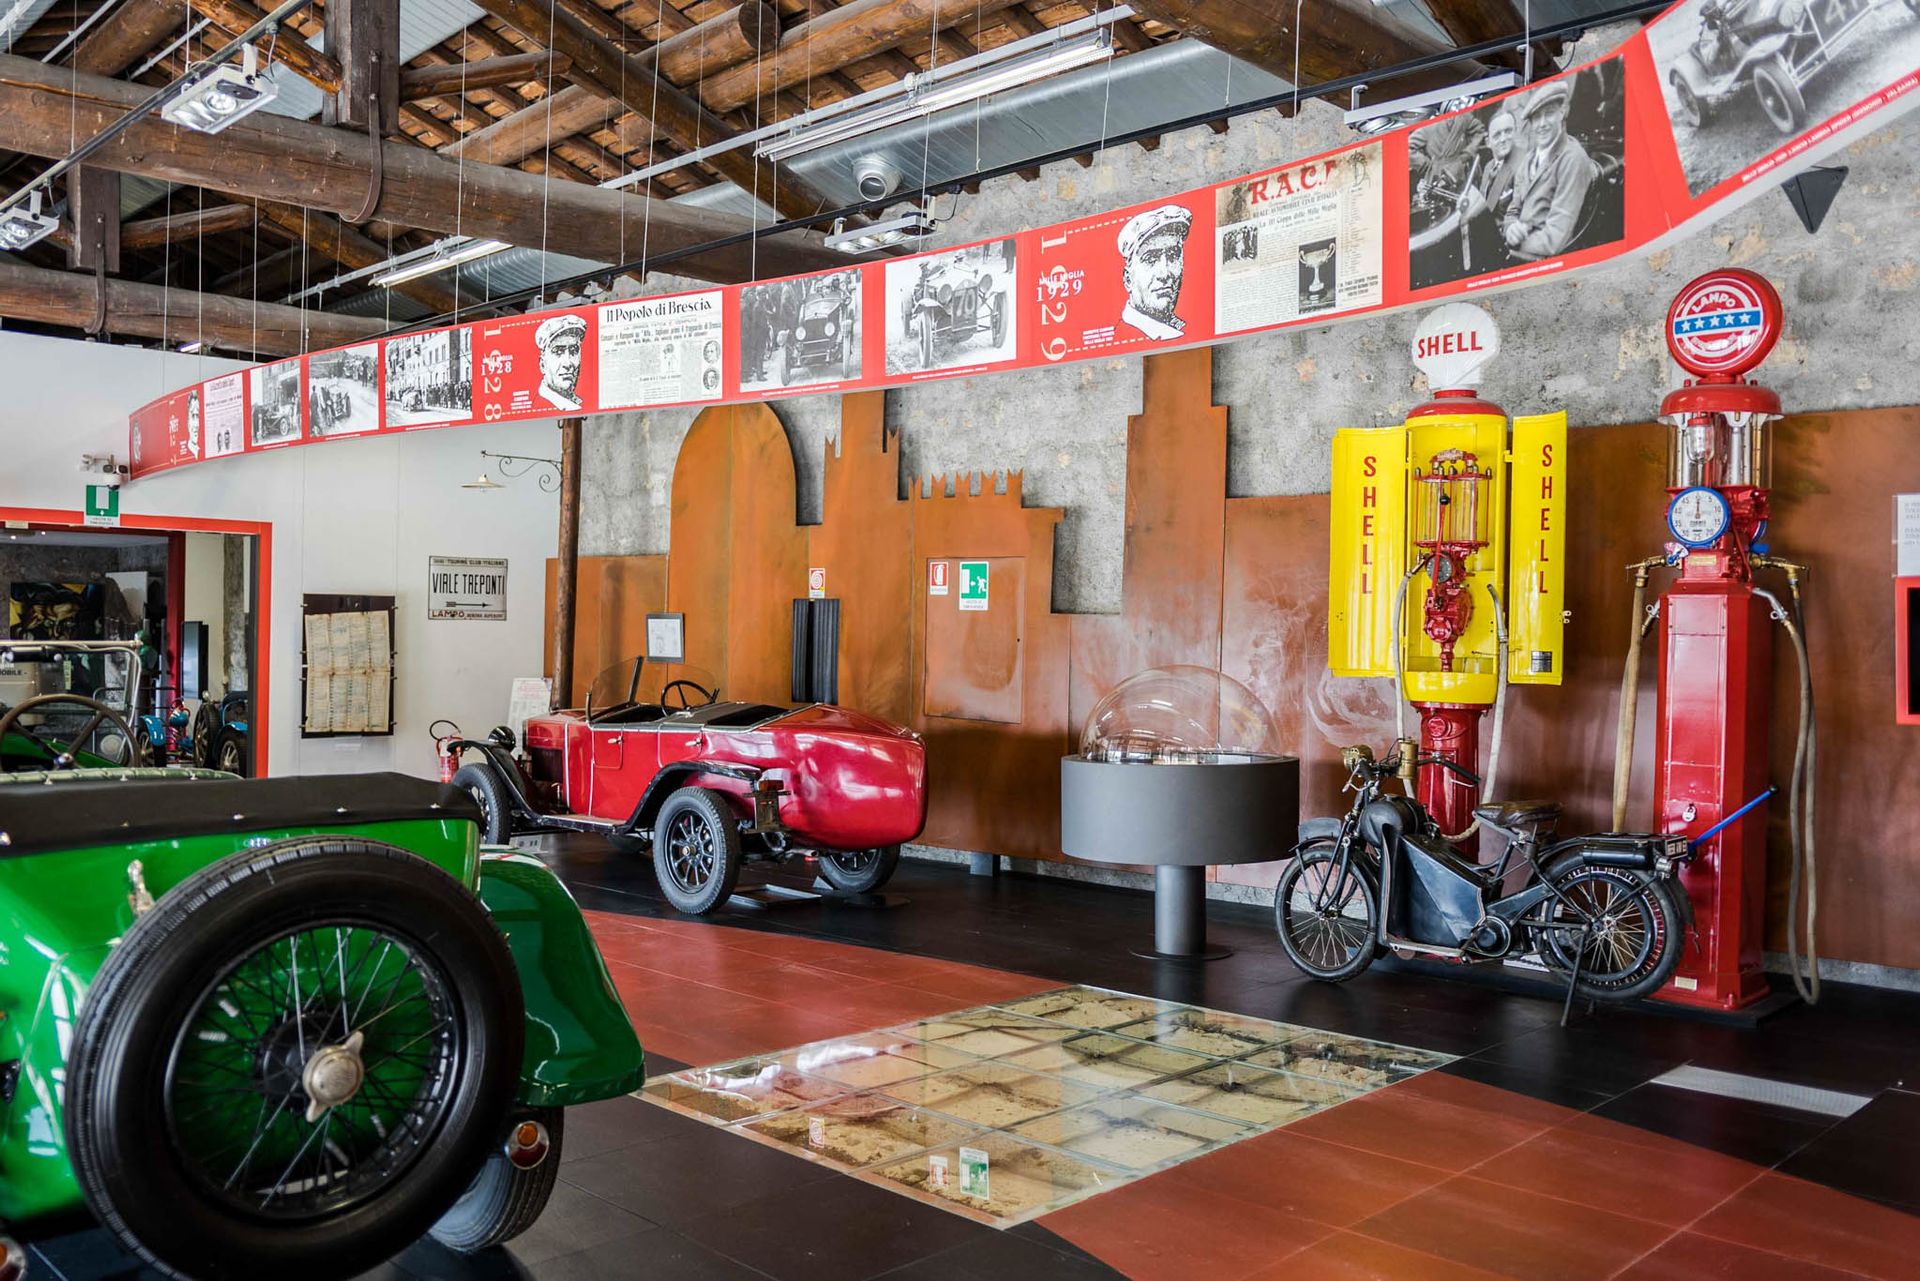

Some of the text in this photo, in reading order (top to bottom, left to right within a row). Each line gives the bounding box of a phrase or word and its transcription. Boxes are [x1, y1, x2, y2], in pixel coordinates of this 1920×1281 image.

[1037, 279, 1083, 302] 1929
[615, 305, 652, 321] Popolo
[655, 303, 666, 316] di
[668, 298, 712, 315] Brescia
[1692, 292, 1736, 313] LAMPO
[1417, 331, 1483, 359] SHELL
[481, 361, 512, 376] 1928
[1361, 455, 1377, 595] SHELL
[1539, 444, 1553, 594] SHELL
[433, 573, 505, 594] VIALE TREPONTI
[432, 610, 465, 618] LAMPO
